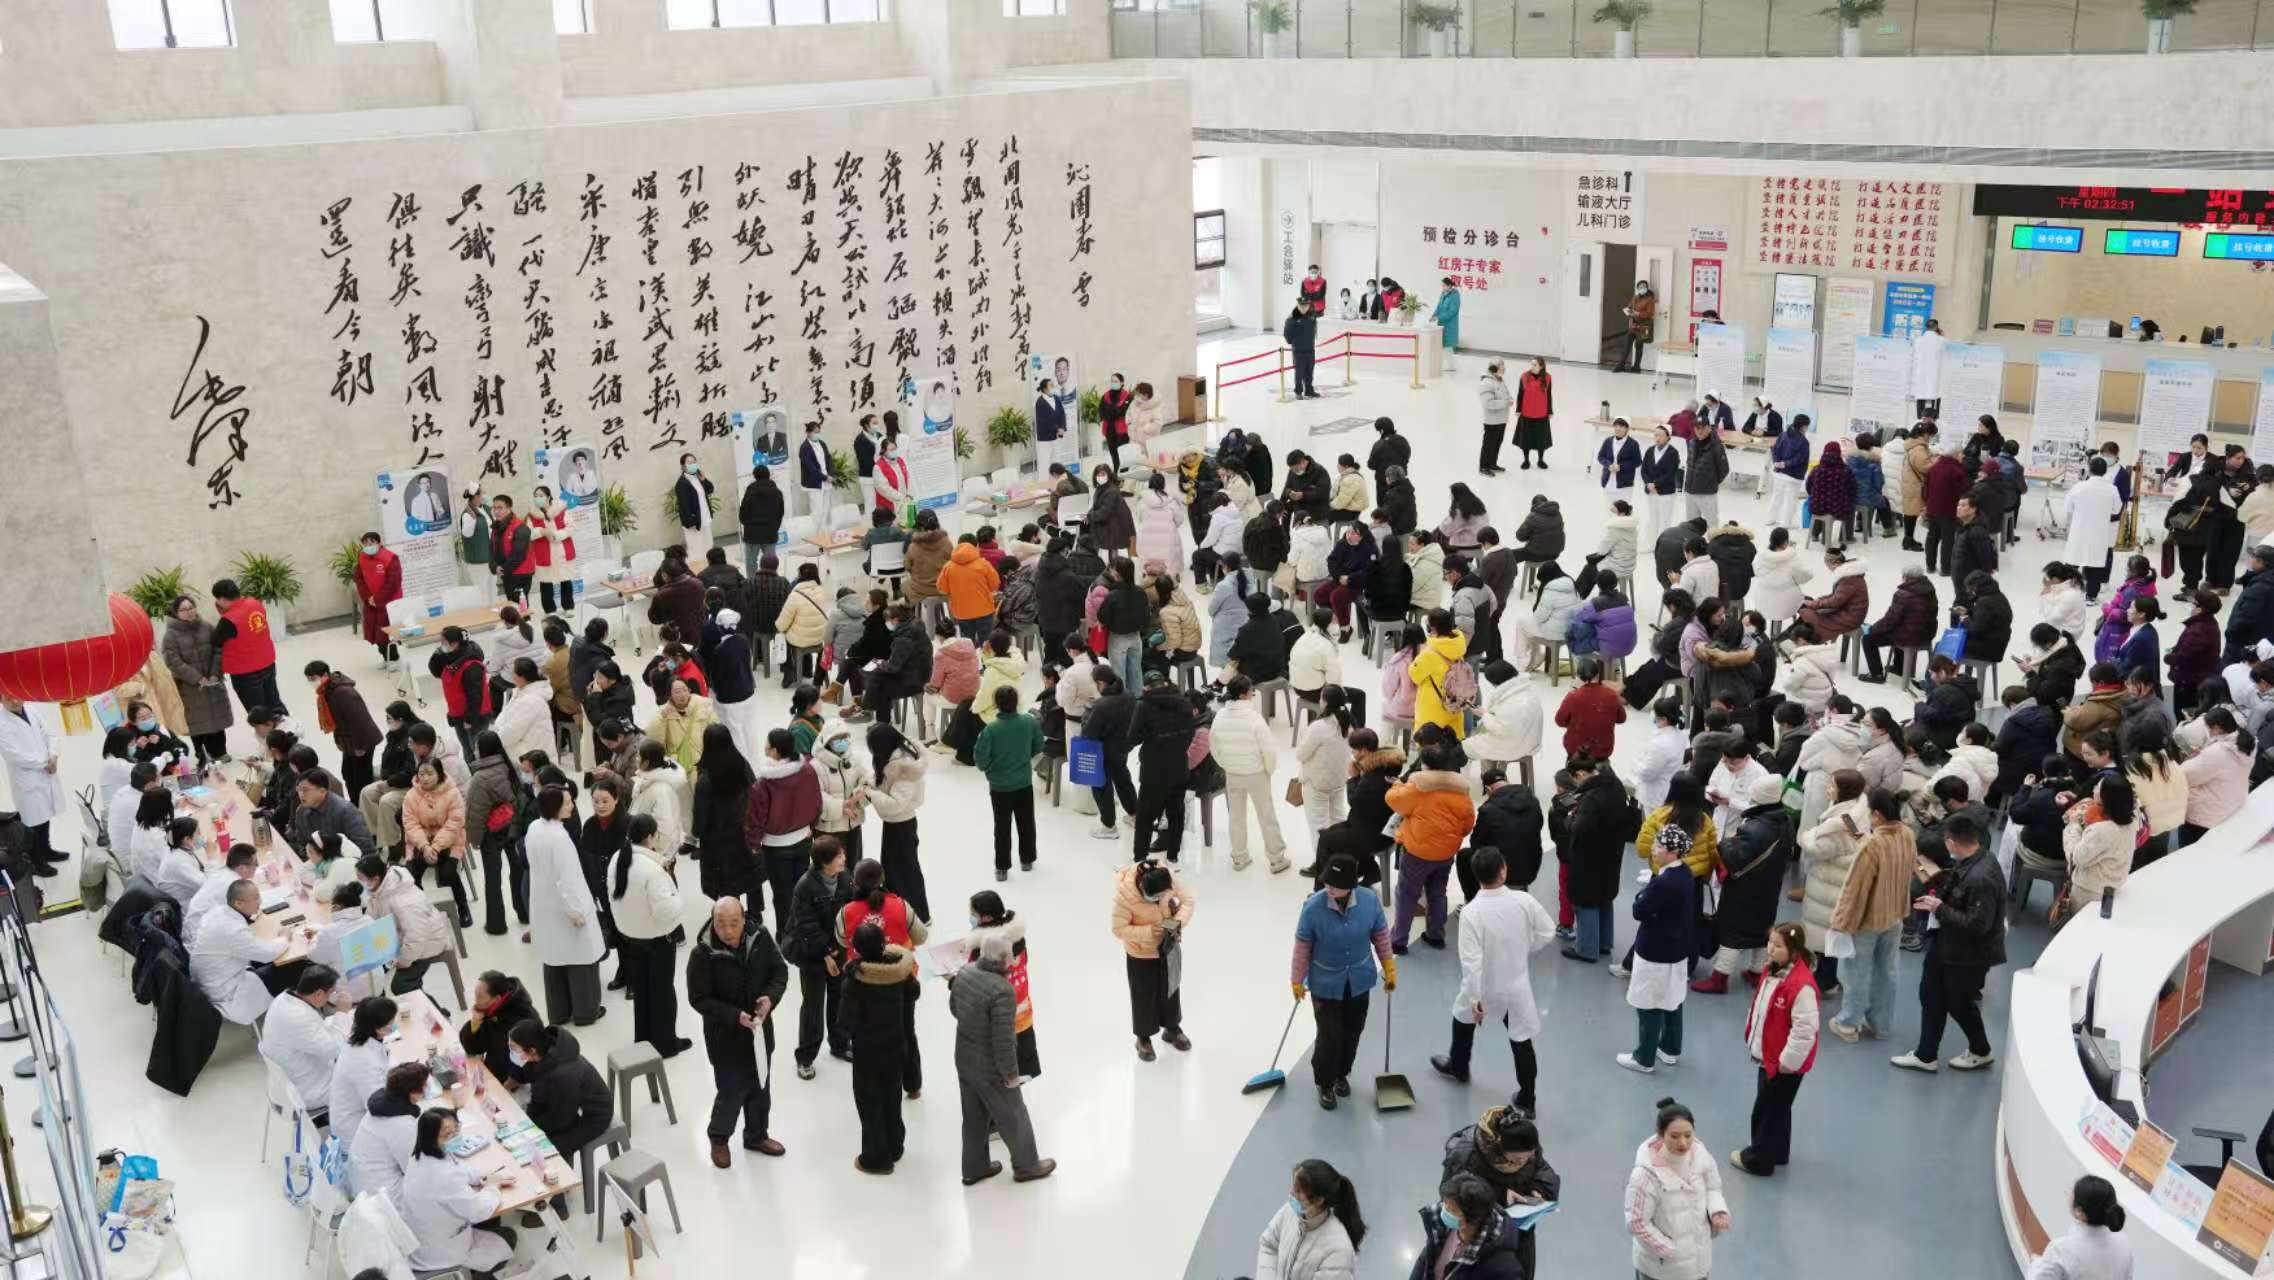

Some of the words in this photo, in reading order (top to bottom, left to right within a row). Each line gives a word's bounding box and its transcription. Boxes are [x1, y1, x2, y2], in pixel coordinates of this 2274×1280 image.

[1578, 175, 1618, 191] 急诊科
[1577, 194, 1632, 210] 输液大厅
[2057, 196, 2081, 209] 下午
[1577, 212, 1631, 229] 儿科门诊
[1423, 226, 1520, 248] 预检分诊台
[2038, 234, 2074, 245] 挂号收费
[2131, 238, 2171, 249] 挂号收费
[2232, 242, 2273, 253] 挂号收费
[1438, 256, 1502, 273] 红房子专家
